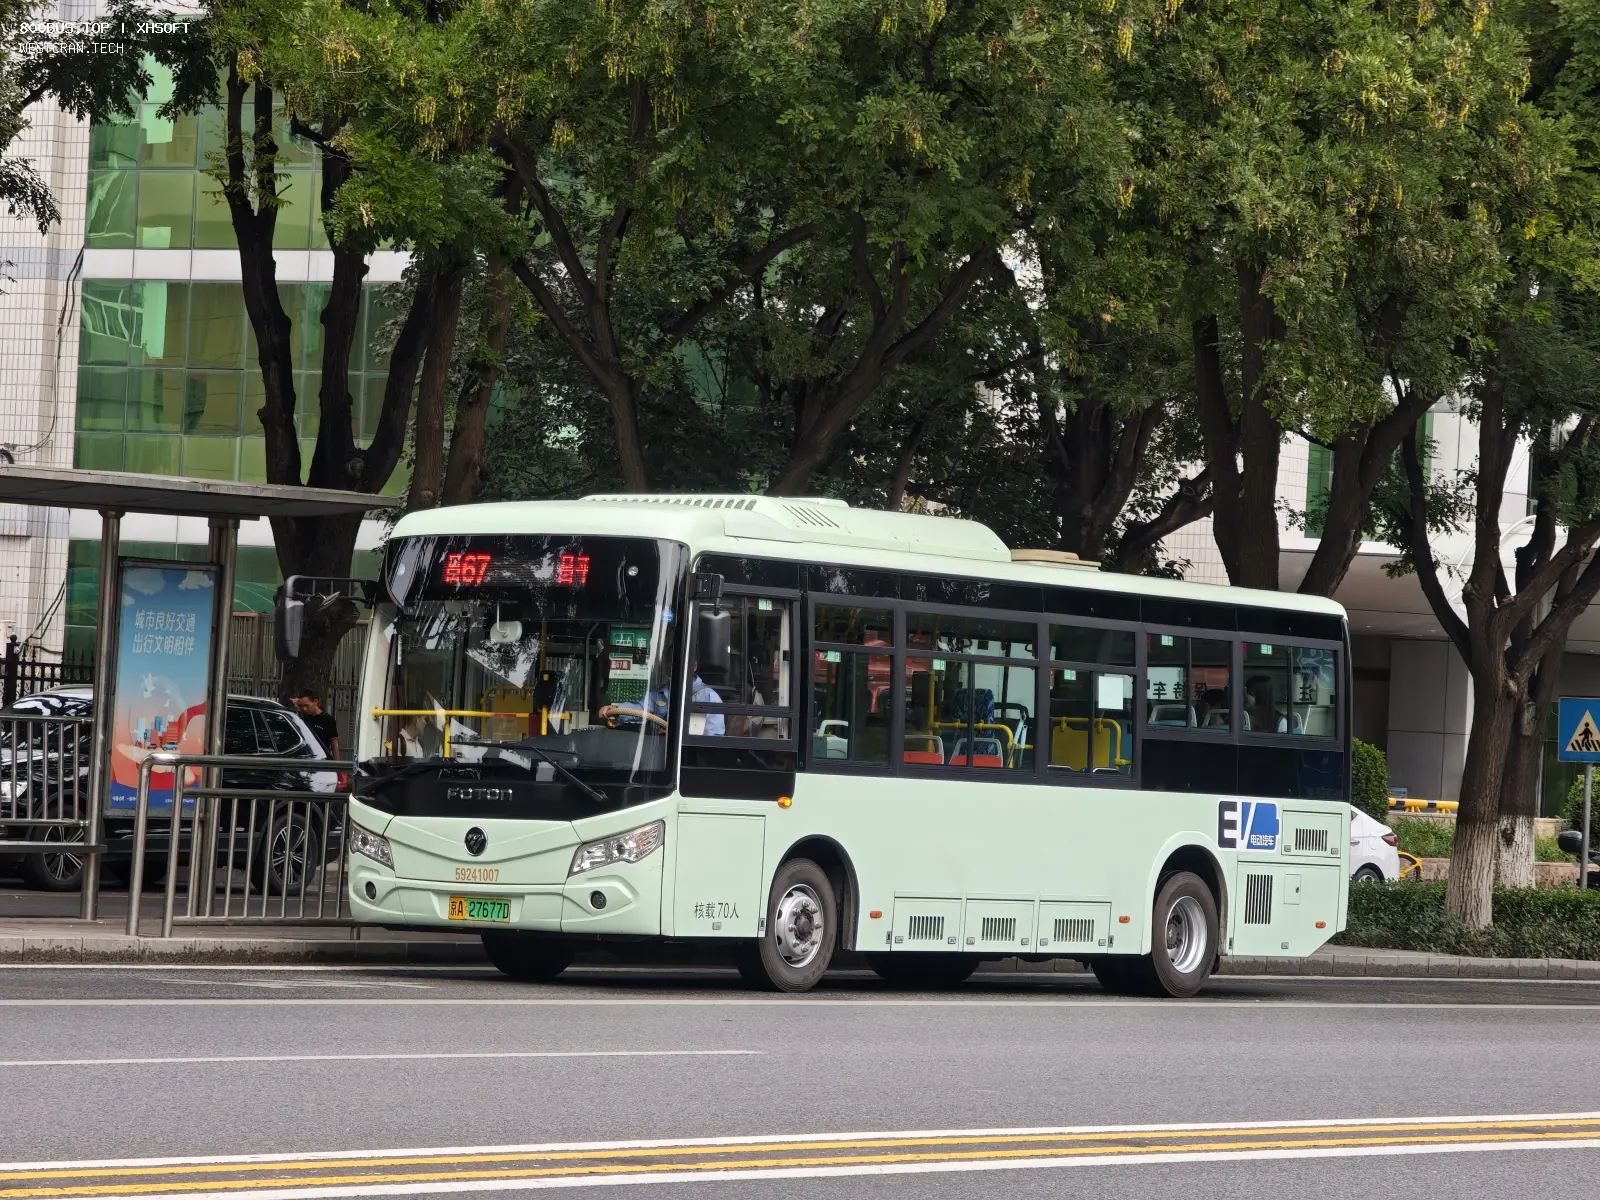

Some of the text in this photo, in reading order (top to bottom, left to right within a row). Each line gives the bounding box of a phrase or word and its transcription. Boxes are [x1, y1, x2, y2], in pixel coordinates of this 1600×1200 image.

[134, 609, 196, 633] 城市良好交通
[132, 633, 195, 656] 出行文明相伴
[447, 787, 513, 801] FOTON
[1250, 834, 1275, 847] 电动汽车
[455, 867, 500, 882] 59241007
